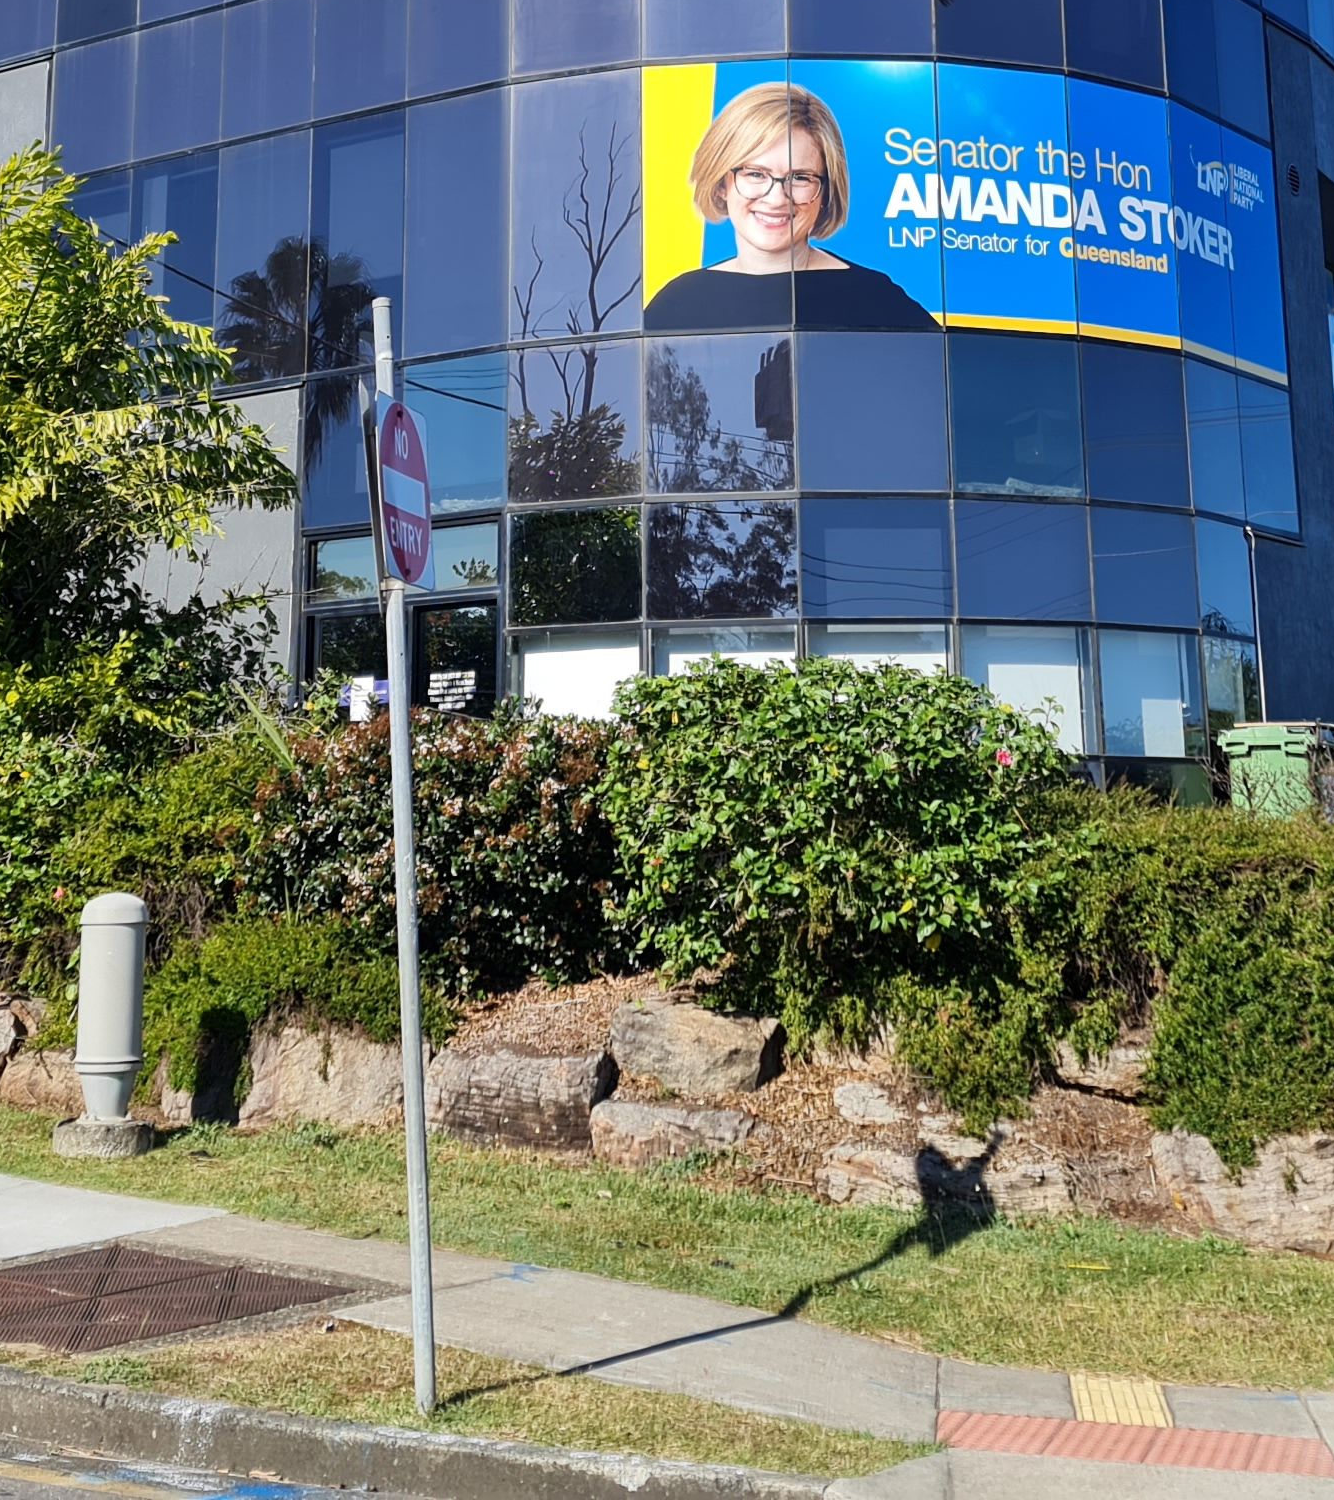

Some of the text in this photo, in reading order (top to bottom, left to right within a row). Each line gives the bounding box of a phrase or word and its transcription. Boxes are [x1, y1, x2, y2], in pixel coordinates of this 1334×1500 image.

[884, 127, 1151, 192] Senator the Hon
[1233, 164, 1260, 188] LIBERAL
[1197, 161, 1226, 198] LNP
[1233, 179, 1264, 204] NATIONAL
[1233, 193, 1255, 212] PARTY
[883, 172, 1234, 271] AMANDA STOKER
[888, 226, 1168, 274] LNP Senator for Queensland
[394, 426, 409, 460] NO
[389, 516, 423, 557] ENTRY
